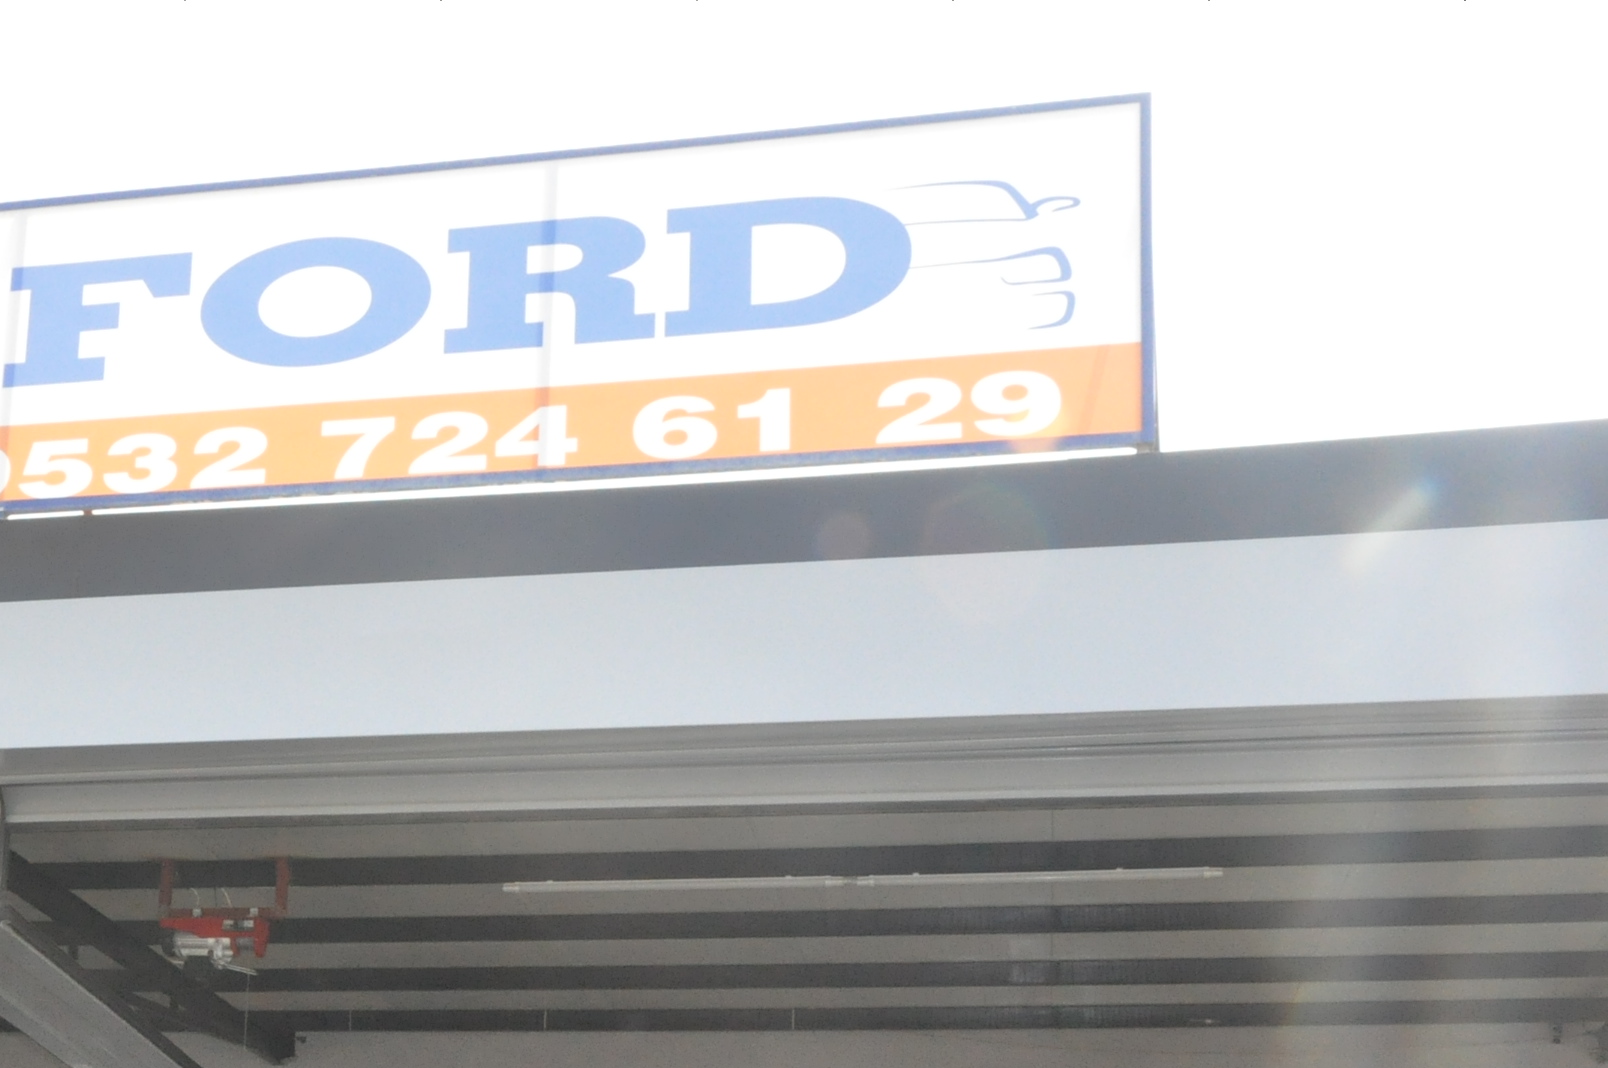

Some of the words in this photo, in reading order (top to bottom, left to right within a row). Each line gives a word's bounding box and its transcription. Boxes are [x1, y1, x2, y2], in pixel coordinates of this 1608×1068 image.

[1, 196, 913, 388] FORD
[318, 404, 582, 483] 724
[632, 387, 791, 461] 61
[875, 369, 1063, 445] 29
